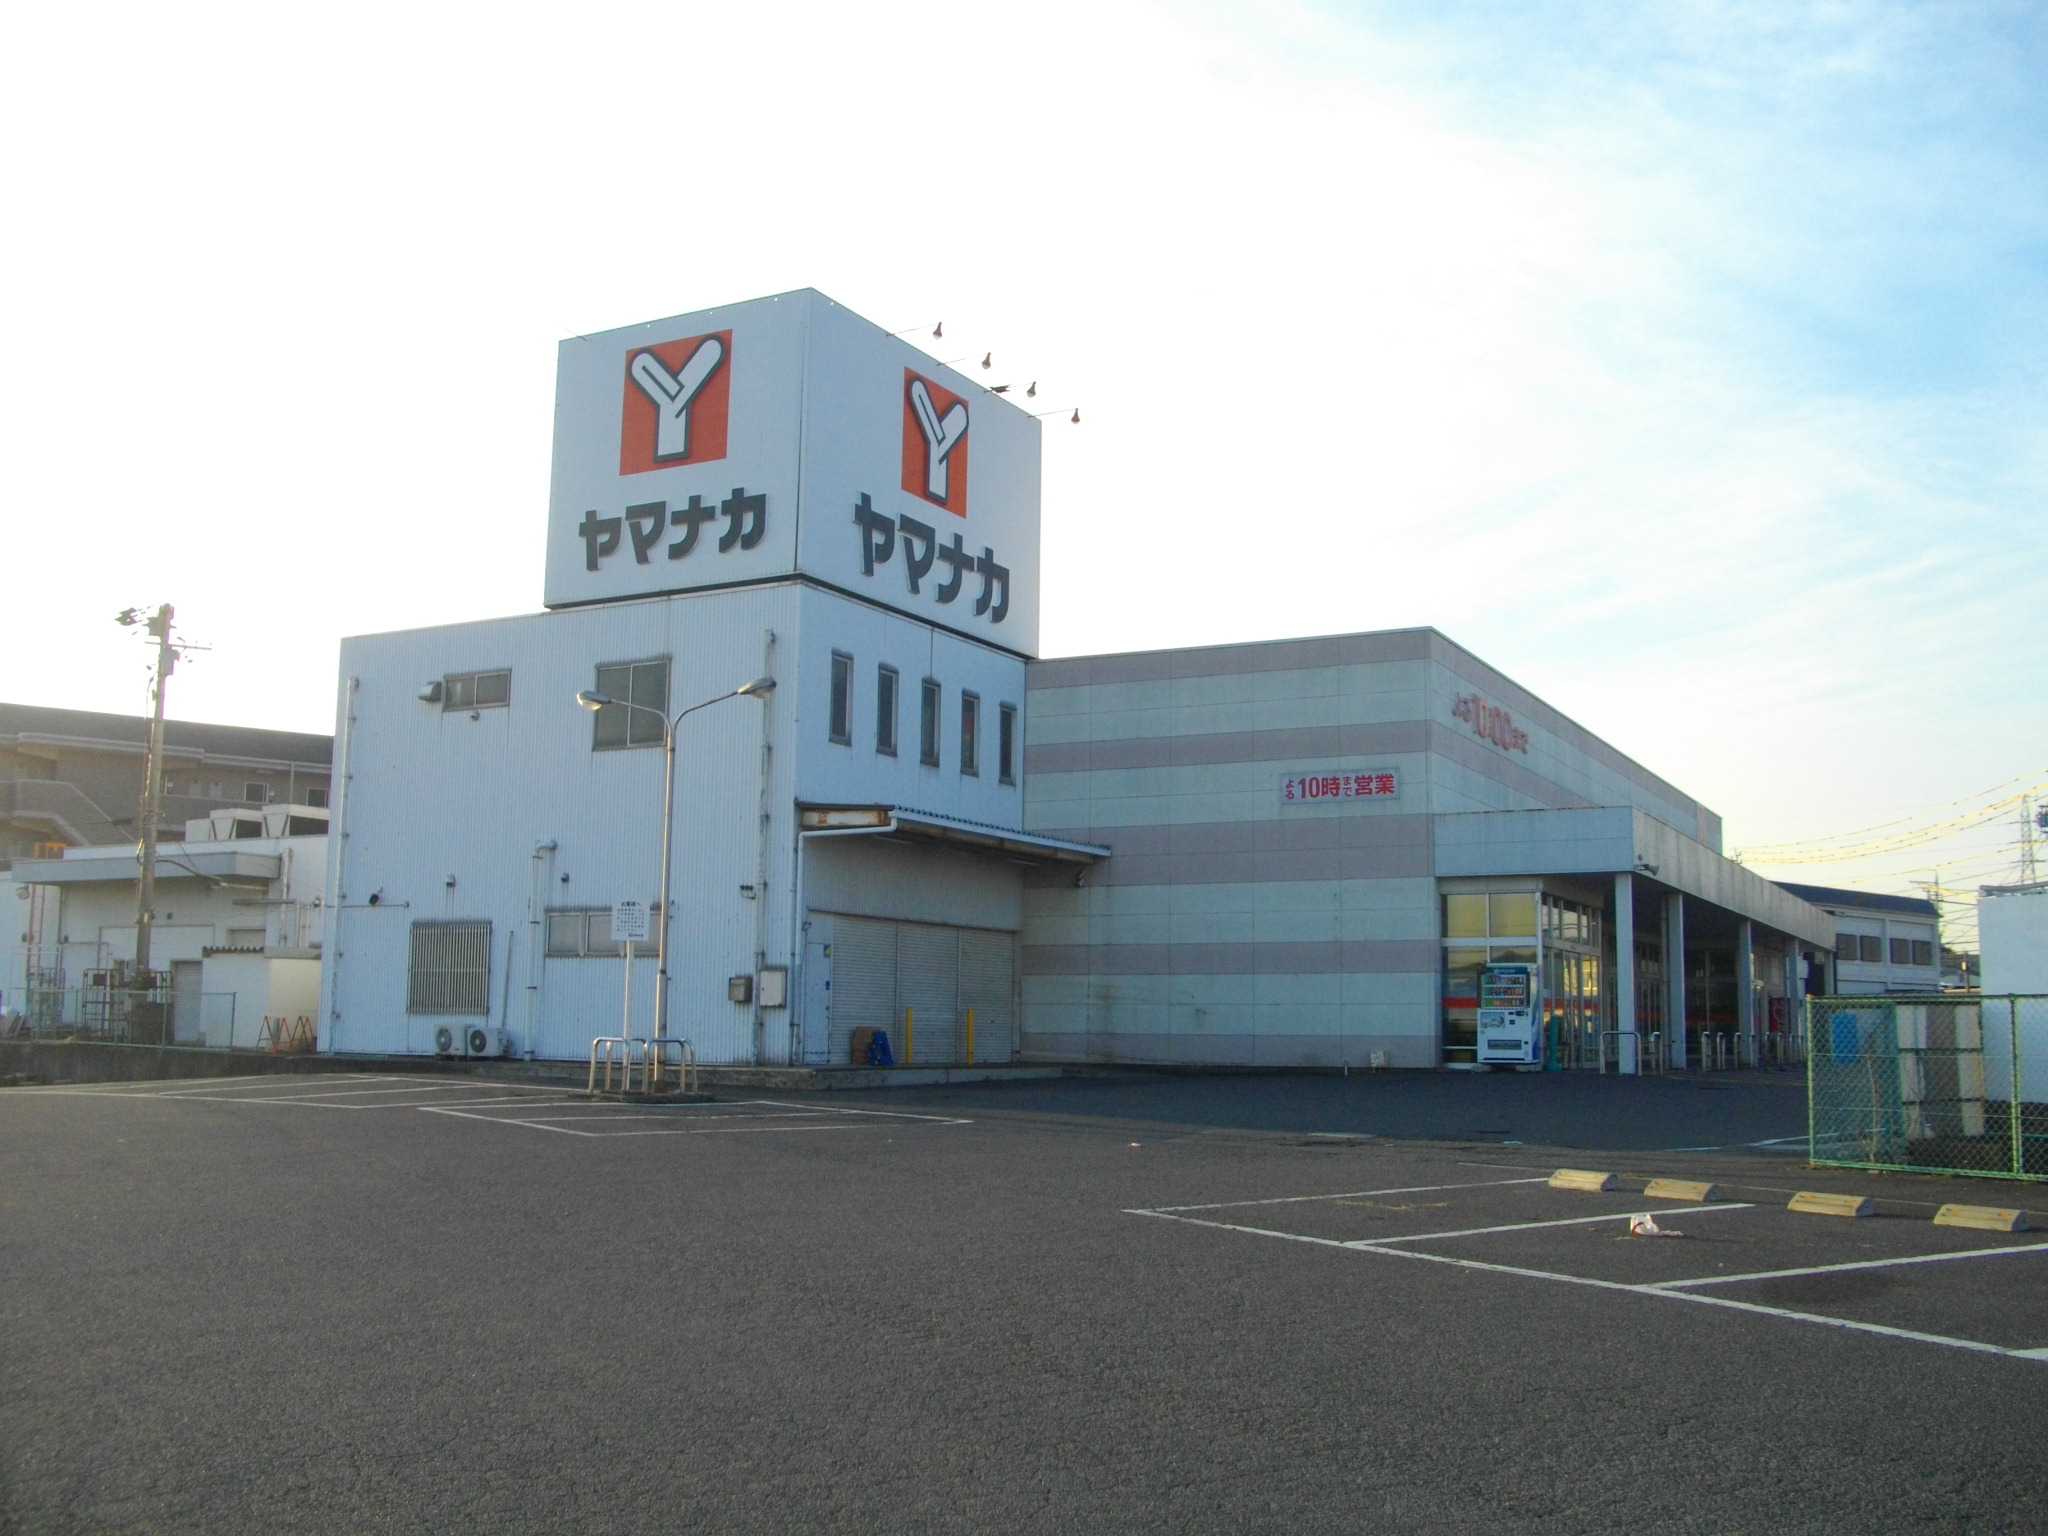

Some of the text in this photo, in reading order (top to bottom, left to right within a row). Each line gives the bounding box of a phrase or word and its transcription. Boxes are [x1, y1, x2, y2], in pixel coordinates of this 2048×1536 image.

[578, 486, 767, 572] ヤマナカ
[853, 491, 1010, 624] ヤマナカ
[1285, 773, 1395, 800] よる10時まで営業
